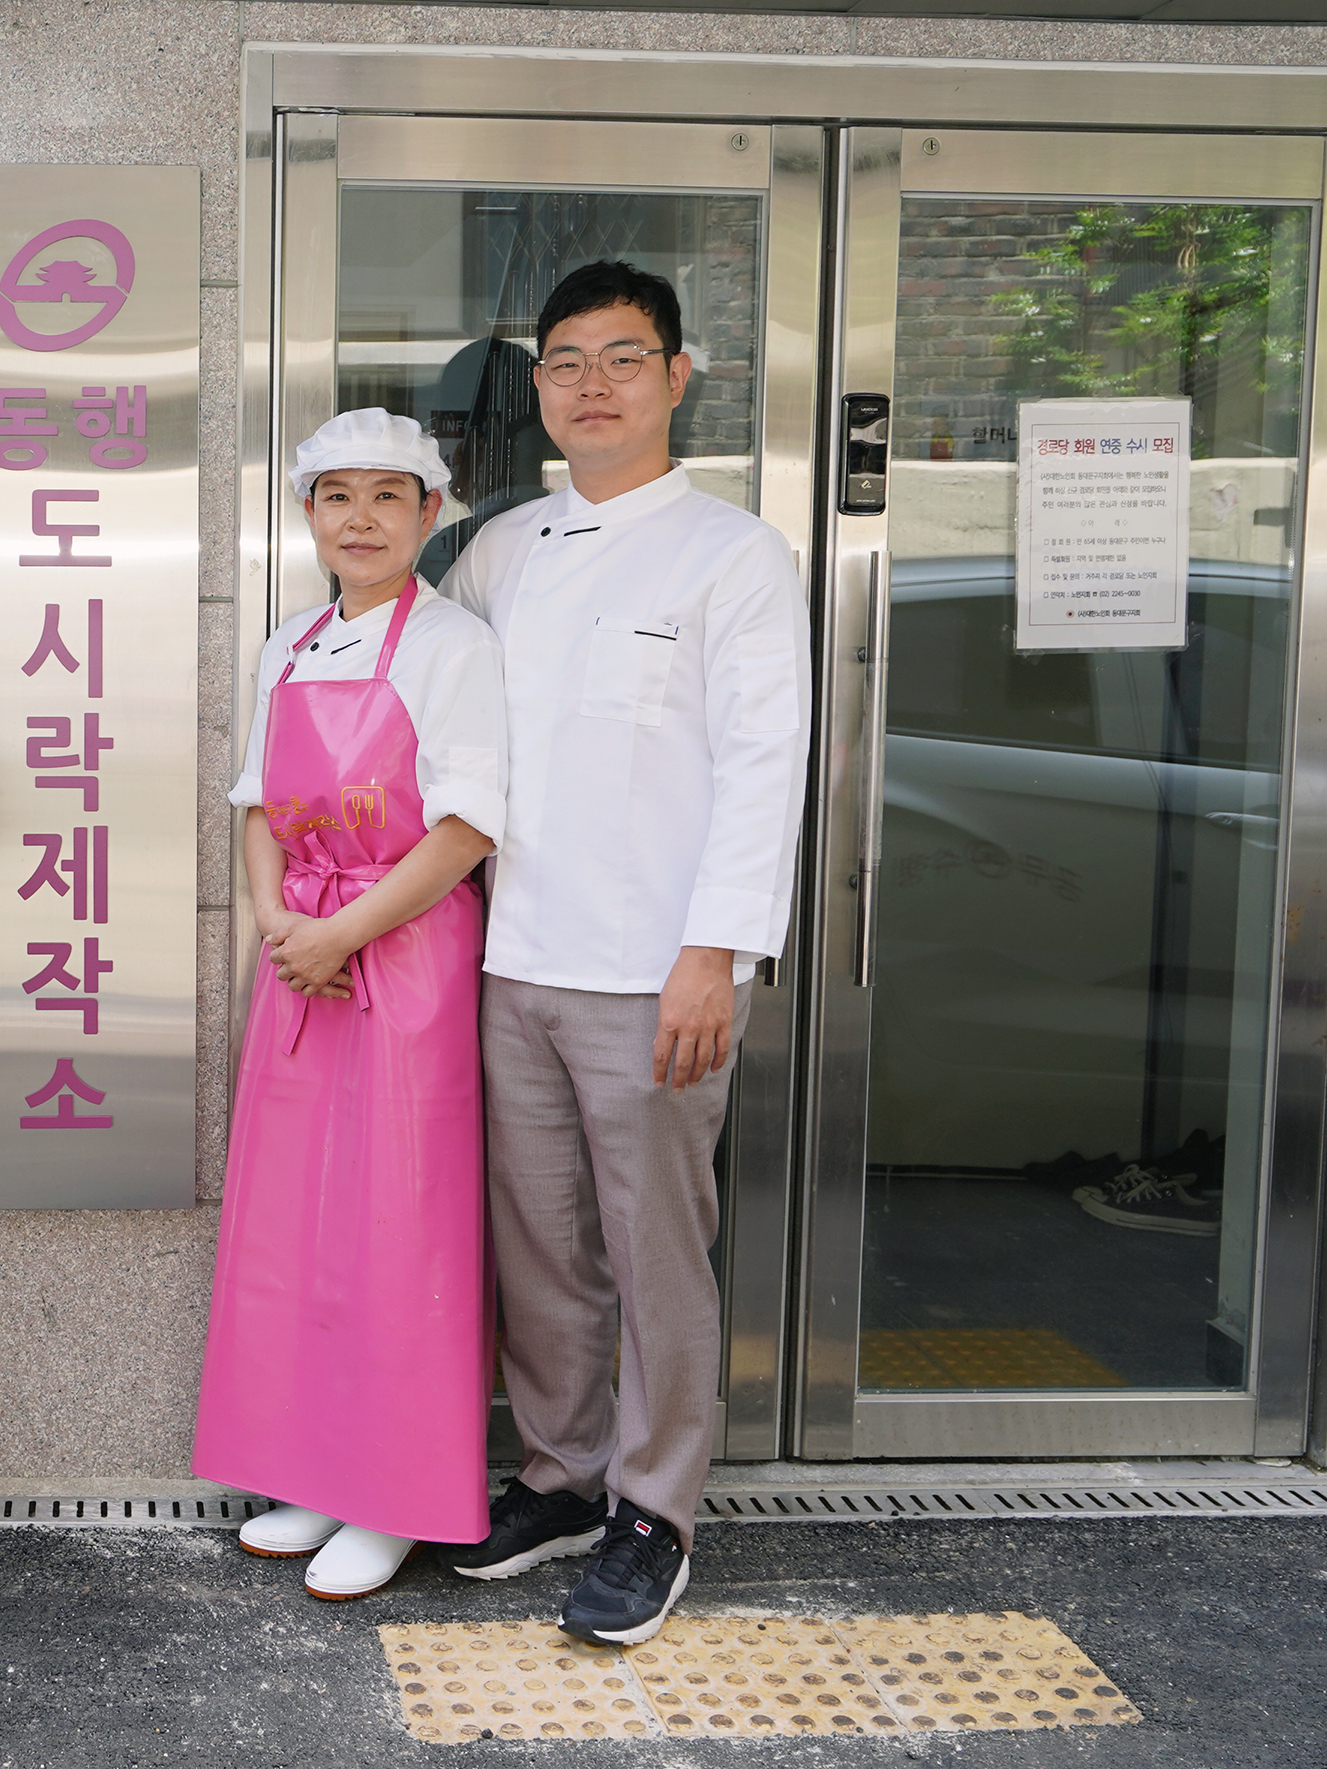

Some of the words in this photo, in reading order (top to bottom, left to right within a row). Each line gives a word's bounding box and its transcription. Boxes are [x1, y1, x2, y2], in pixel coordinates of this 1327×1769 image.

[1037, 439, 1070, 455] 경로당
[1074, 438, 1096, 454] 회원
[1100, 438, 1122, 454] 연중
[1126, 438, 1147, 454] 수시
[1152, 438, 1173, 453] 모집
[17, 489, 114, 1130] 도시락제작소
